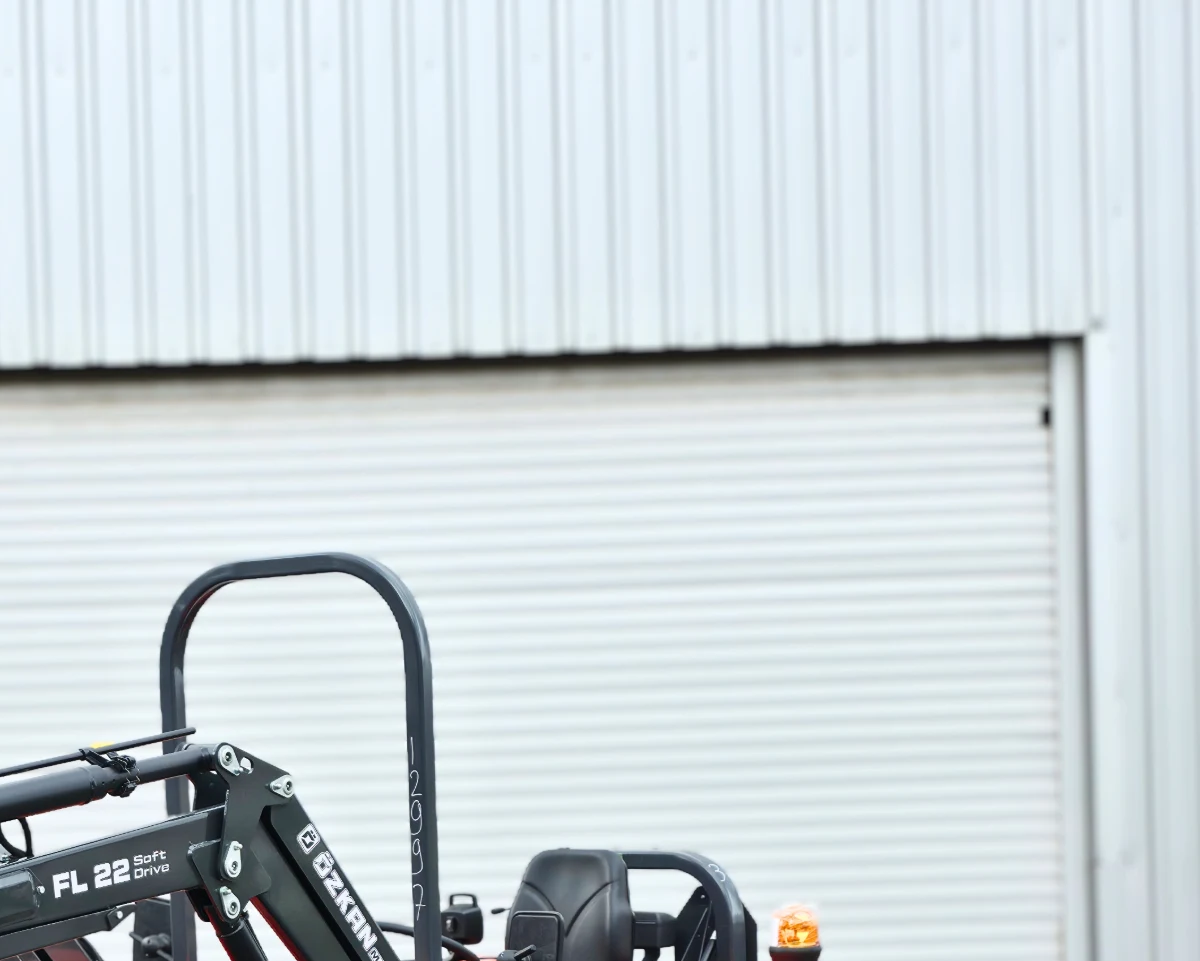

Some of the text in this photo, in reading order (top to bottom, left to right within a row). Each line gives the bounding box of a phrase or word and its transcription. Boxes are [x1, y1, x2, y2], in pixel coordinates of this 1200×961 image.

[133, 850, 167, 866] Soft
[133, 863, 170, 880] Drive
[52, 858, 131, 899] FL 22
[312, 850, 378, 952] ÖZKAN
